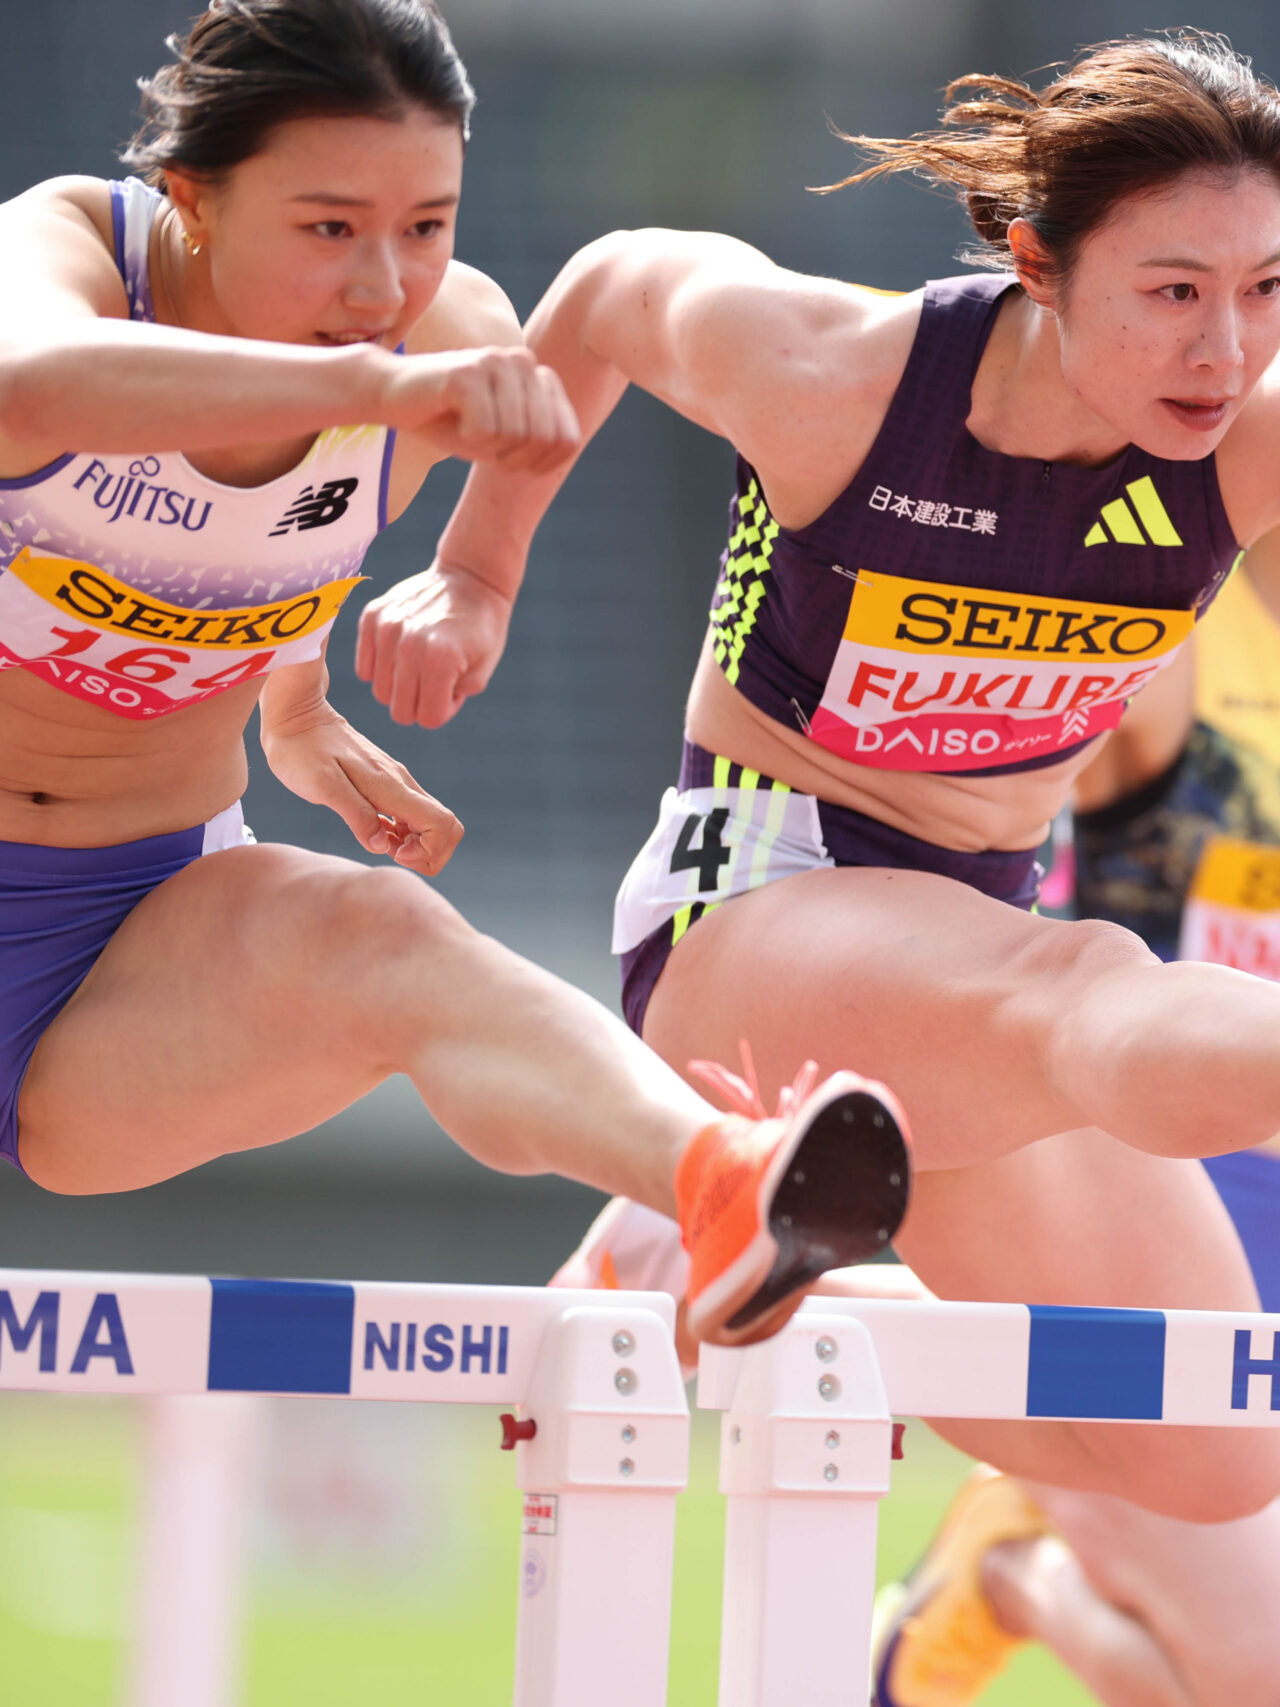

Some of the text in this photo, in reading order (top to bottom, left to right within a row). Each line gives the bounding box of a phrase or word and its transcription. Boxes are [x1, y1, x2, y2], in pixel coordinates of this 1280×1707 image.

[72, 458, 214, 532] FUJITSU
[868, 485, 998, 535] 日本建設工業
[55, 569, 321, 645] SEIKO
[894, 592, 1167, 656] SEIKO
[854, 727, 1000, 757] DAISO
[669, 807, 731, 893] 4
[0, 1289, 136, 1376] MA
[363, 1321, 510, 1375] NISHI
